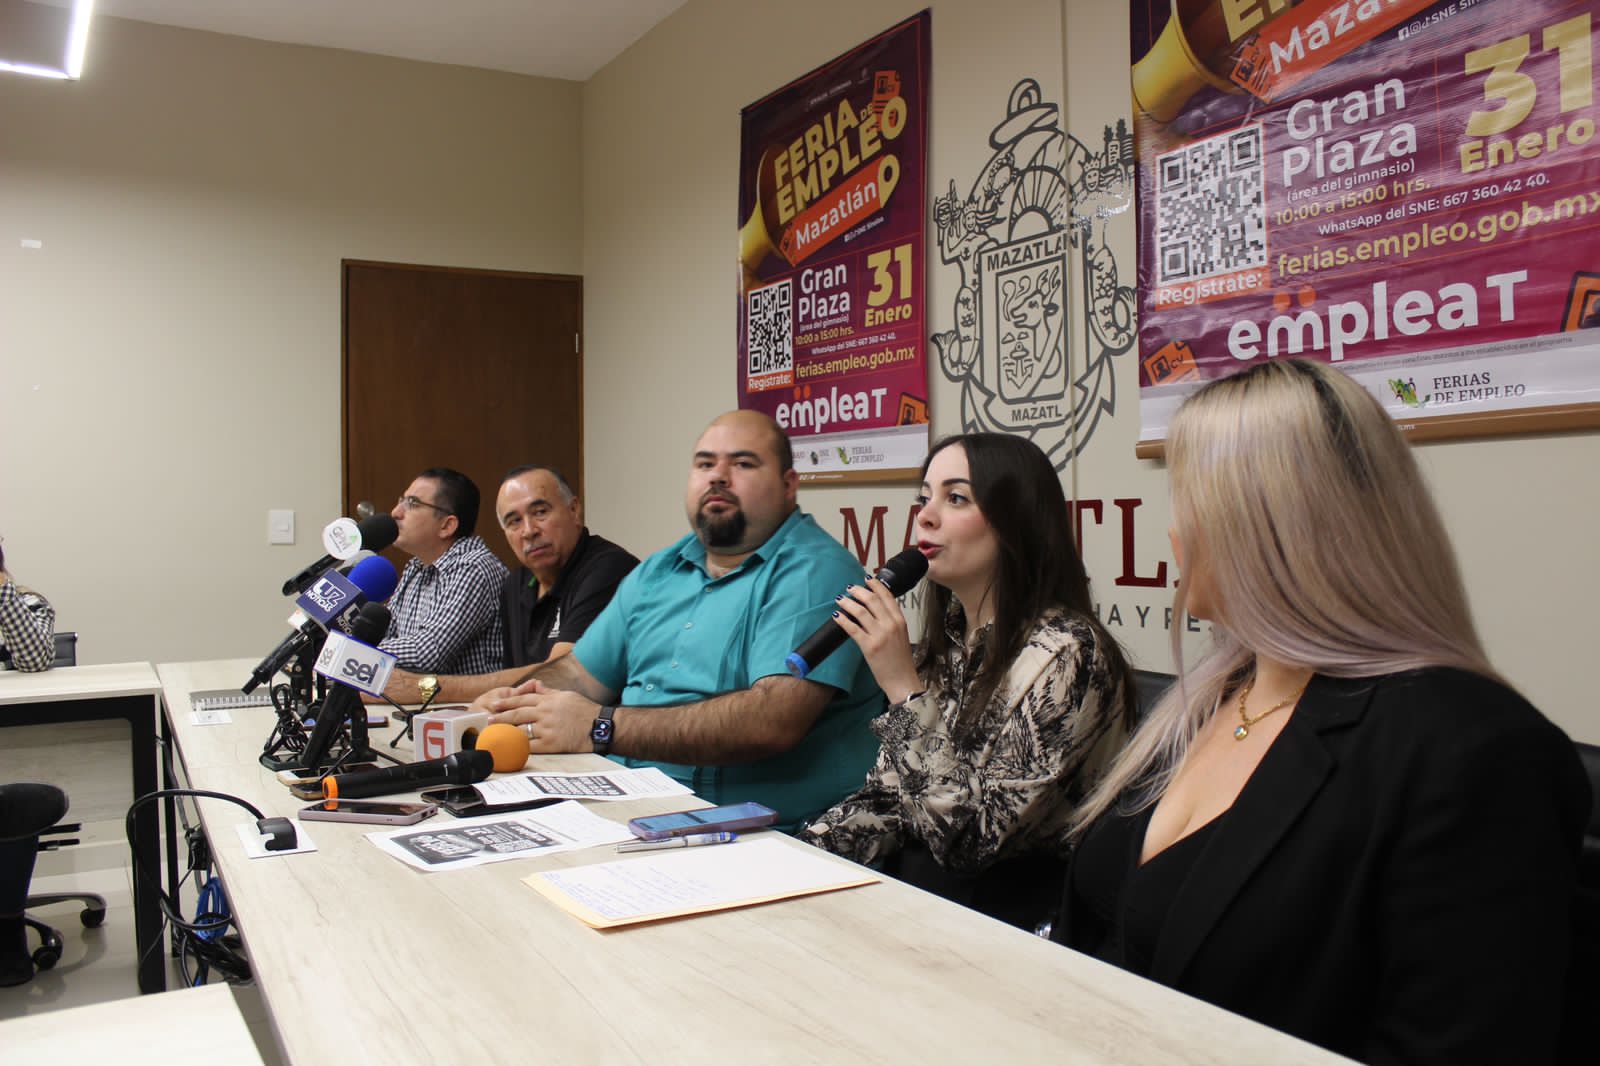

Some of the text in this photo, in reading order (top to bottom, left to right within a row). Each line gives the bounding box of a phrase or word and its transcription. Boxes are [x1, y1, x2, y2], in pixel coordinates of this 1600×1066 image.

[1431, 4, 1457, 24] SNE
[1465, 11, 1593, 137] 31
[1286, 78, 1406, 141] Gran
[774, 99, 859, 189] FERIA
[777, 96, 907, 225] EMPLEO
[1282, 122, 1417, 187] Plaza
[1460, 118, 1595, 174] Enero
[1321, 178, 1342, 193] del
[1344, 158, 1415, 189] gimnasio)
[796, 182, 877, 250] Mazatlán
[1275, 178, 1431, 225] 10:00 a 15:00 hrs.
[1318, 172, 1550, 235] WhatsApp del SNE: 667 360 42 40.
[1279, 191, 1600, 277] ferias.empleo.gob.mx
[801, 264, 847, 294] Gran
[867, 244, 912, 307] 31
[799, 292, 850, 322] Plaza
[864, 303, 913, 328] Enero
[795, 326, 855, 346] 10:00 a 15:00 hrs.
[796, 346, 915, 379] ferias.empleo.gob.mx
[1433, 372, 1490, 389] FERIAS
[1434, 384, 1526, 404] DE EMPLEO
[342, 658, 379, 684] sel
